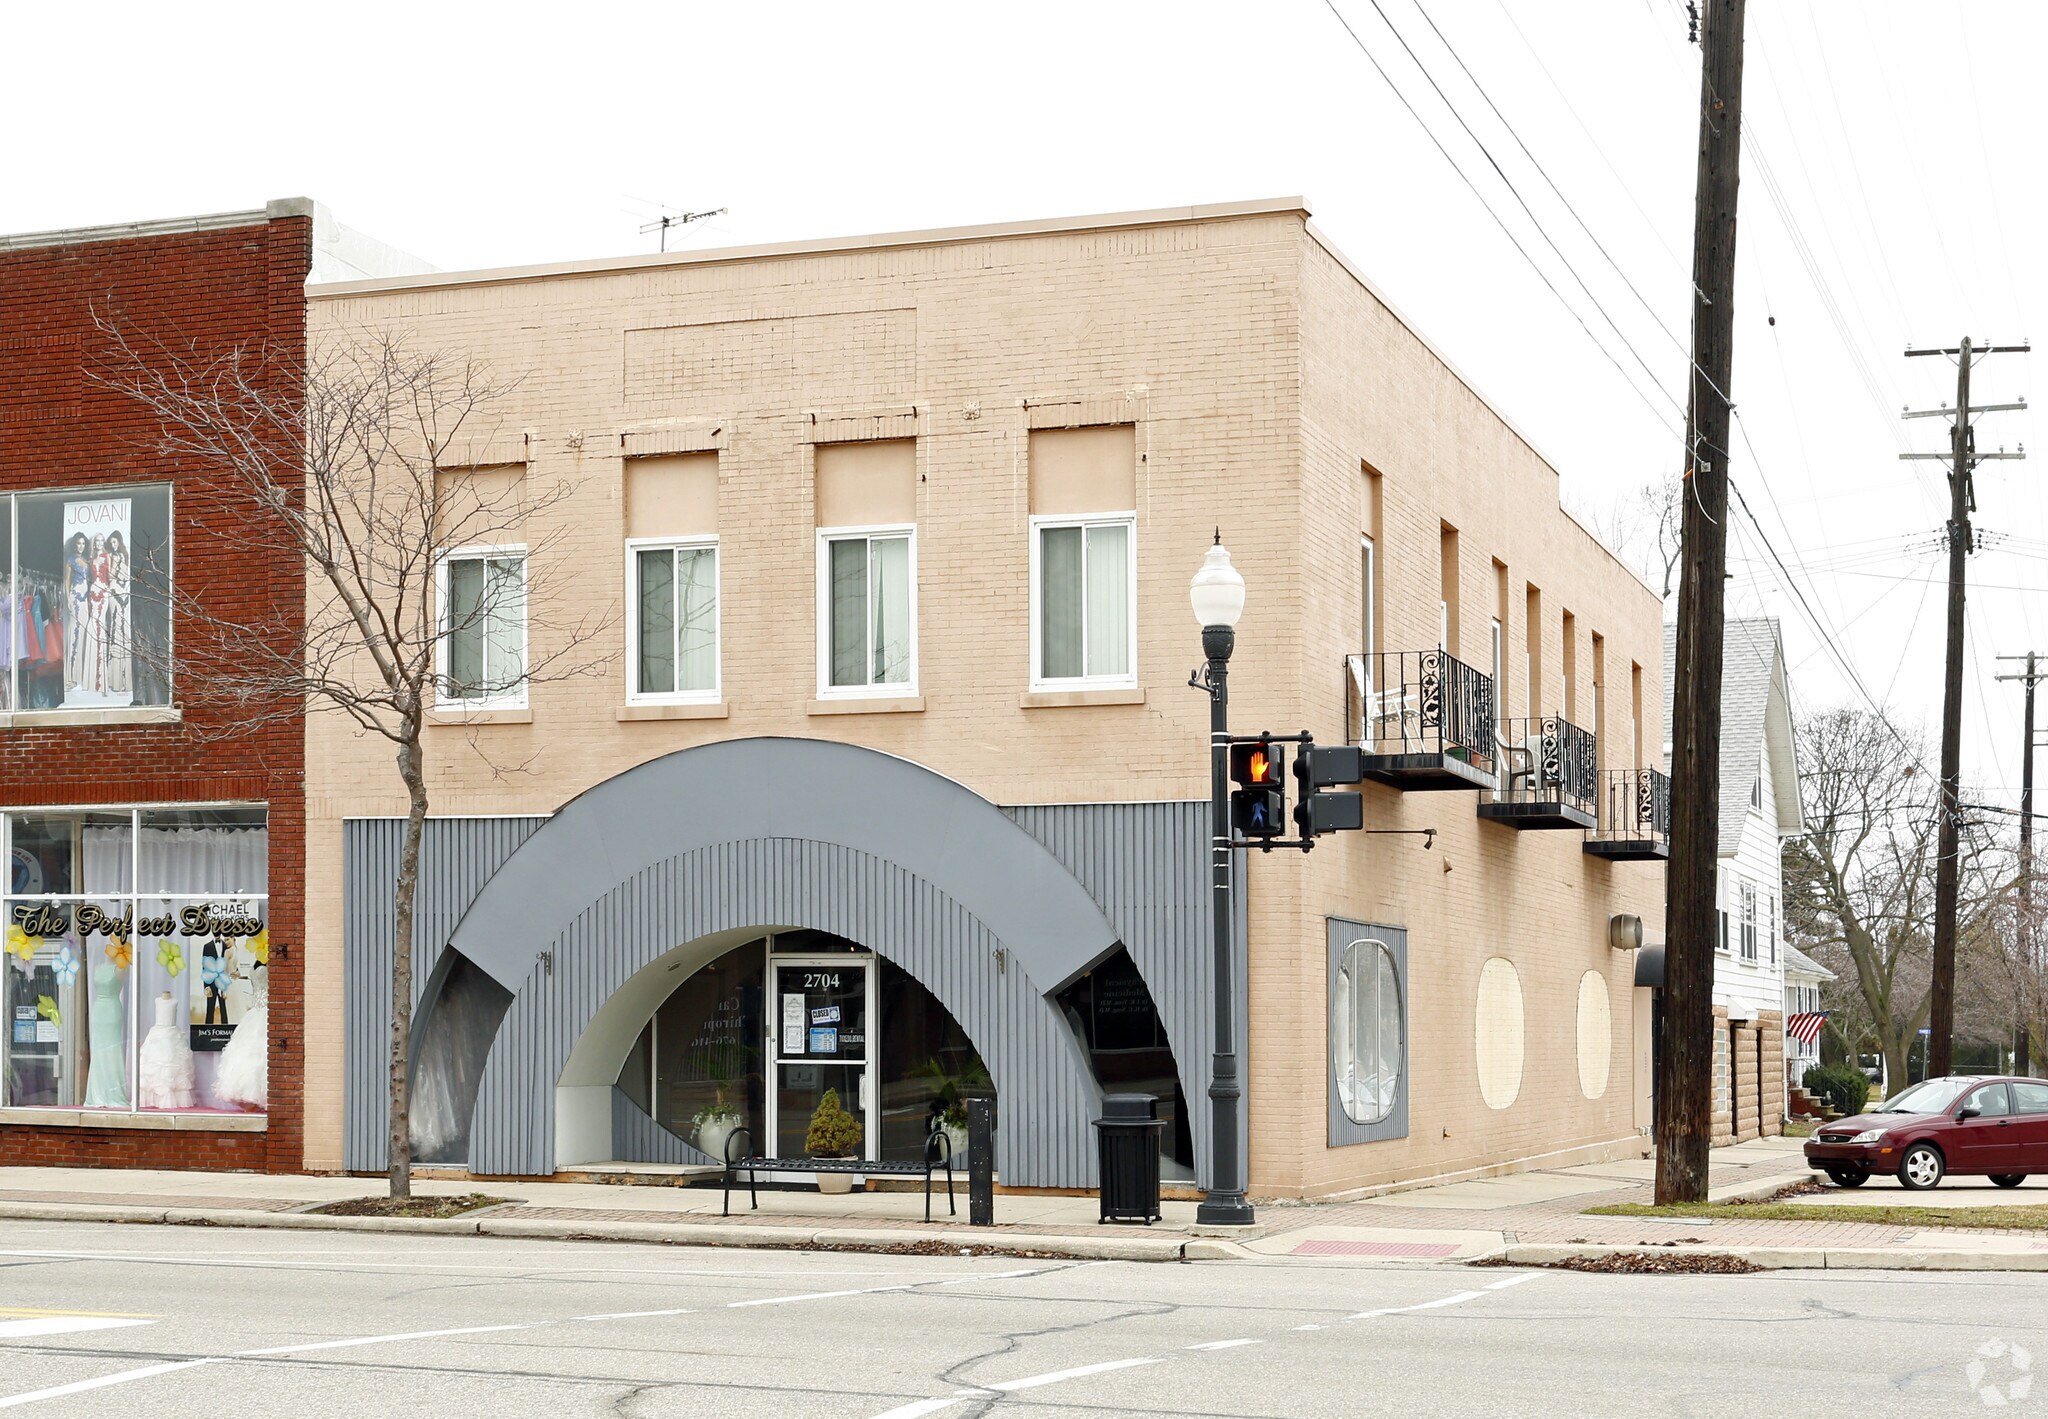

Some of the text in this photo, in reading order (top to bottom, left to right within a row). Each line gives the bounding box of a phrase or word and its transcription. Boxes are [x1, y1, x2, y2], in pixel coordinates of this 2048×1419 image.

[67, 503, 127, 525] JOVANI
[207, 904, 249, 915] ICHAEL
[13, 903, 264, 945] The Perfect Dress
[804, 973, 840, 988] 2704
[813, 1008, 829, 1019] CLOSED
[198, 1029, 212, 1037] JIM'S
